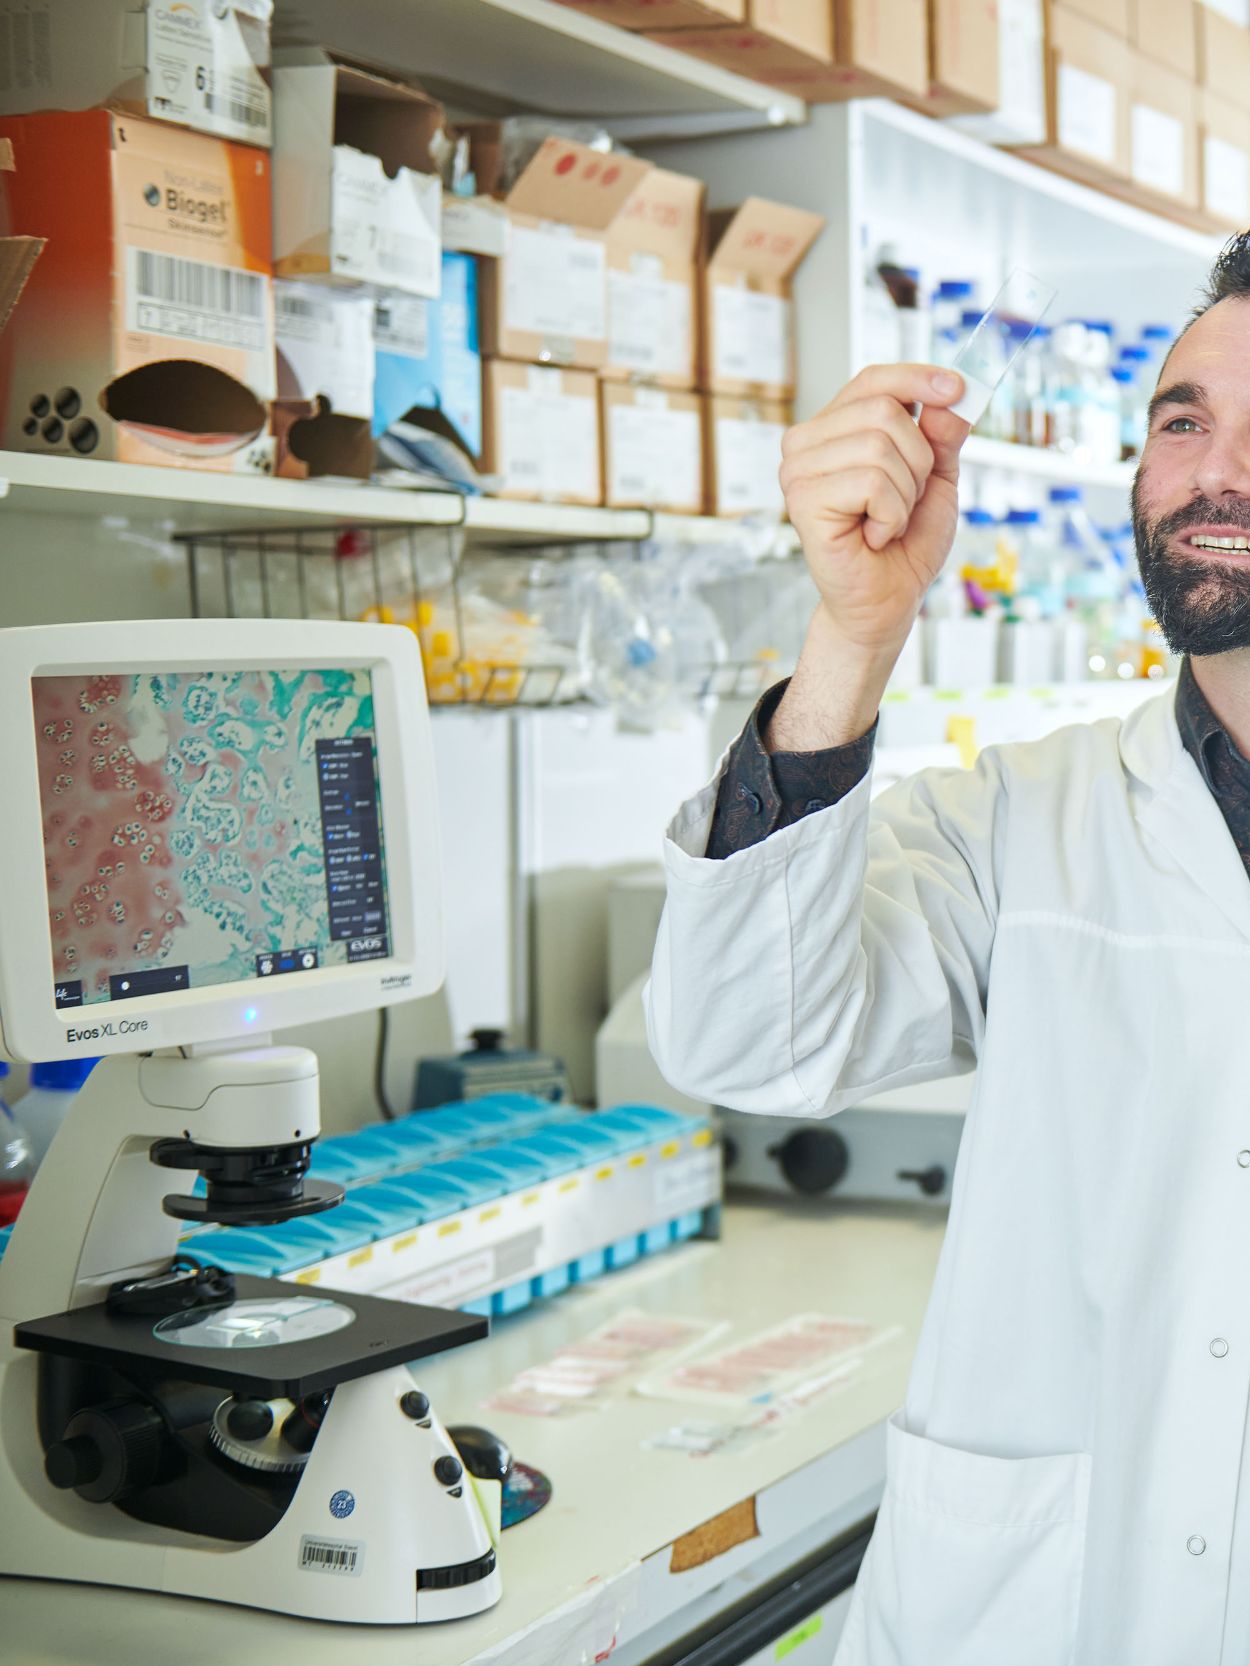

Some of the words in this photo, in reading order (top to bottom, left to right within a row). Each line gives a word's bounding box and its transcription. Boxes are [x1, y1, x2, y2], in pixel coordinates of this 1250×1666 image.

[195, 66, 206, 91] 6
[166, 188, 228, 224] Biogel
[66, 1028, 99, 1042] Evos
[101, 1023, 118, 1037] XL
[119, 1020, 148, 1034] Core
[337, 1500, 347, 1509] 23
